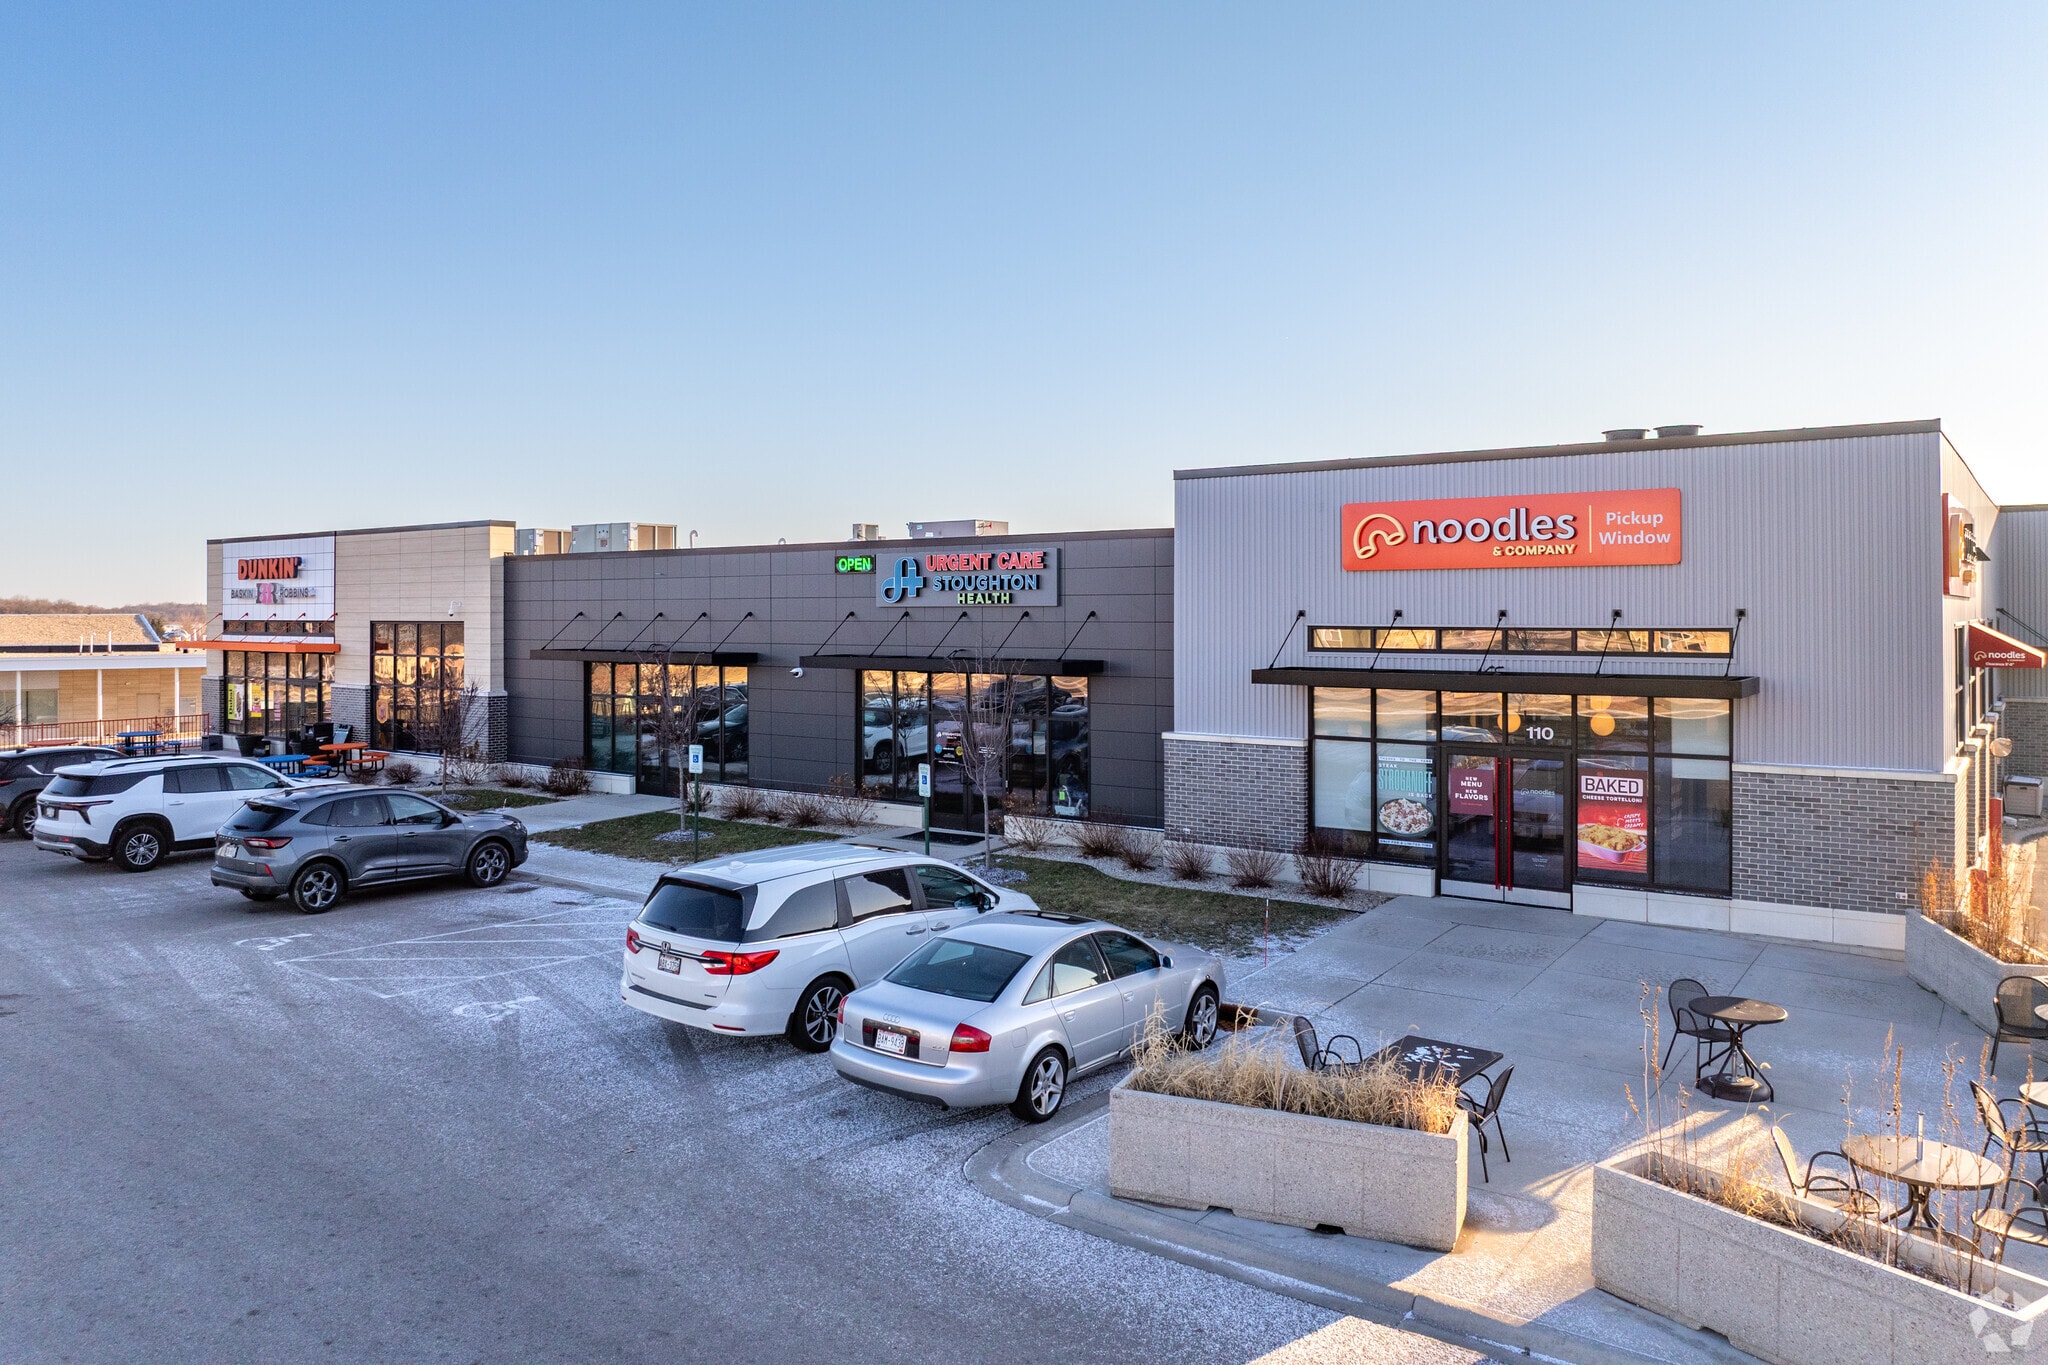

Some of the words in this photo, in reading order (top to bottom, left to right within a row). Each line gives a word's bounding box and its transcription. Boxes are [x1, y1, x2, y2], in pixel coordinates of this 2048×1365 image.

[1413, 507, 1577, 544] noodles
[1606, 511, 1664, 528] Pickup
[1599, 530, 1671, 545] Window
[1493, 546, 1503, 556] &
[1505, 544, 1576, 556] COMPANY
[238, 556, 299, 580] DUNKIN'
[838, 558, 871, 572] OPEN
[926, 553, 992, 571] URGENT
[997, 551, 1044, 569] CARE
[932, 574, 1037, 591] STOUGHTON
[231, 589, 253, 599] BASKIN
[279, 587, 309, 598] ROBBINS
[957, 592, 1011, 605] HEALTH
[1988, 651, 2026, 659] noodles
[1526, 726, 1554, 740] 110
[1378, 768, 1432, 793] STROGANOFF
[1585, 778, 1639, 794] BAKED
[1455, 793, 1489, 801] FLAVORS
[1606, 796, 1643, 804] TORTELLONI
